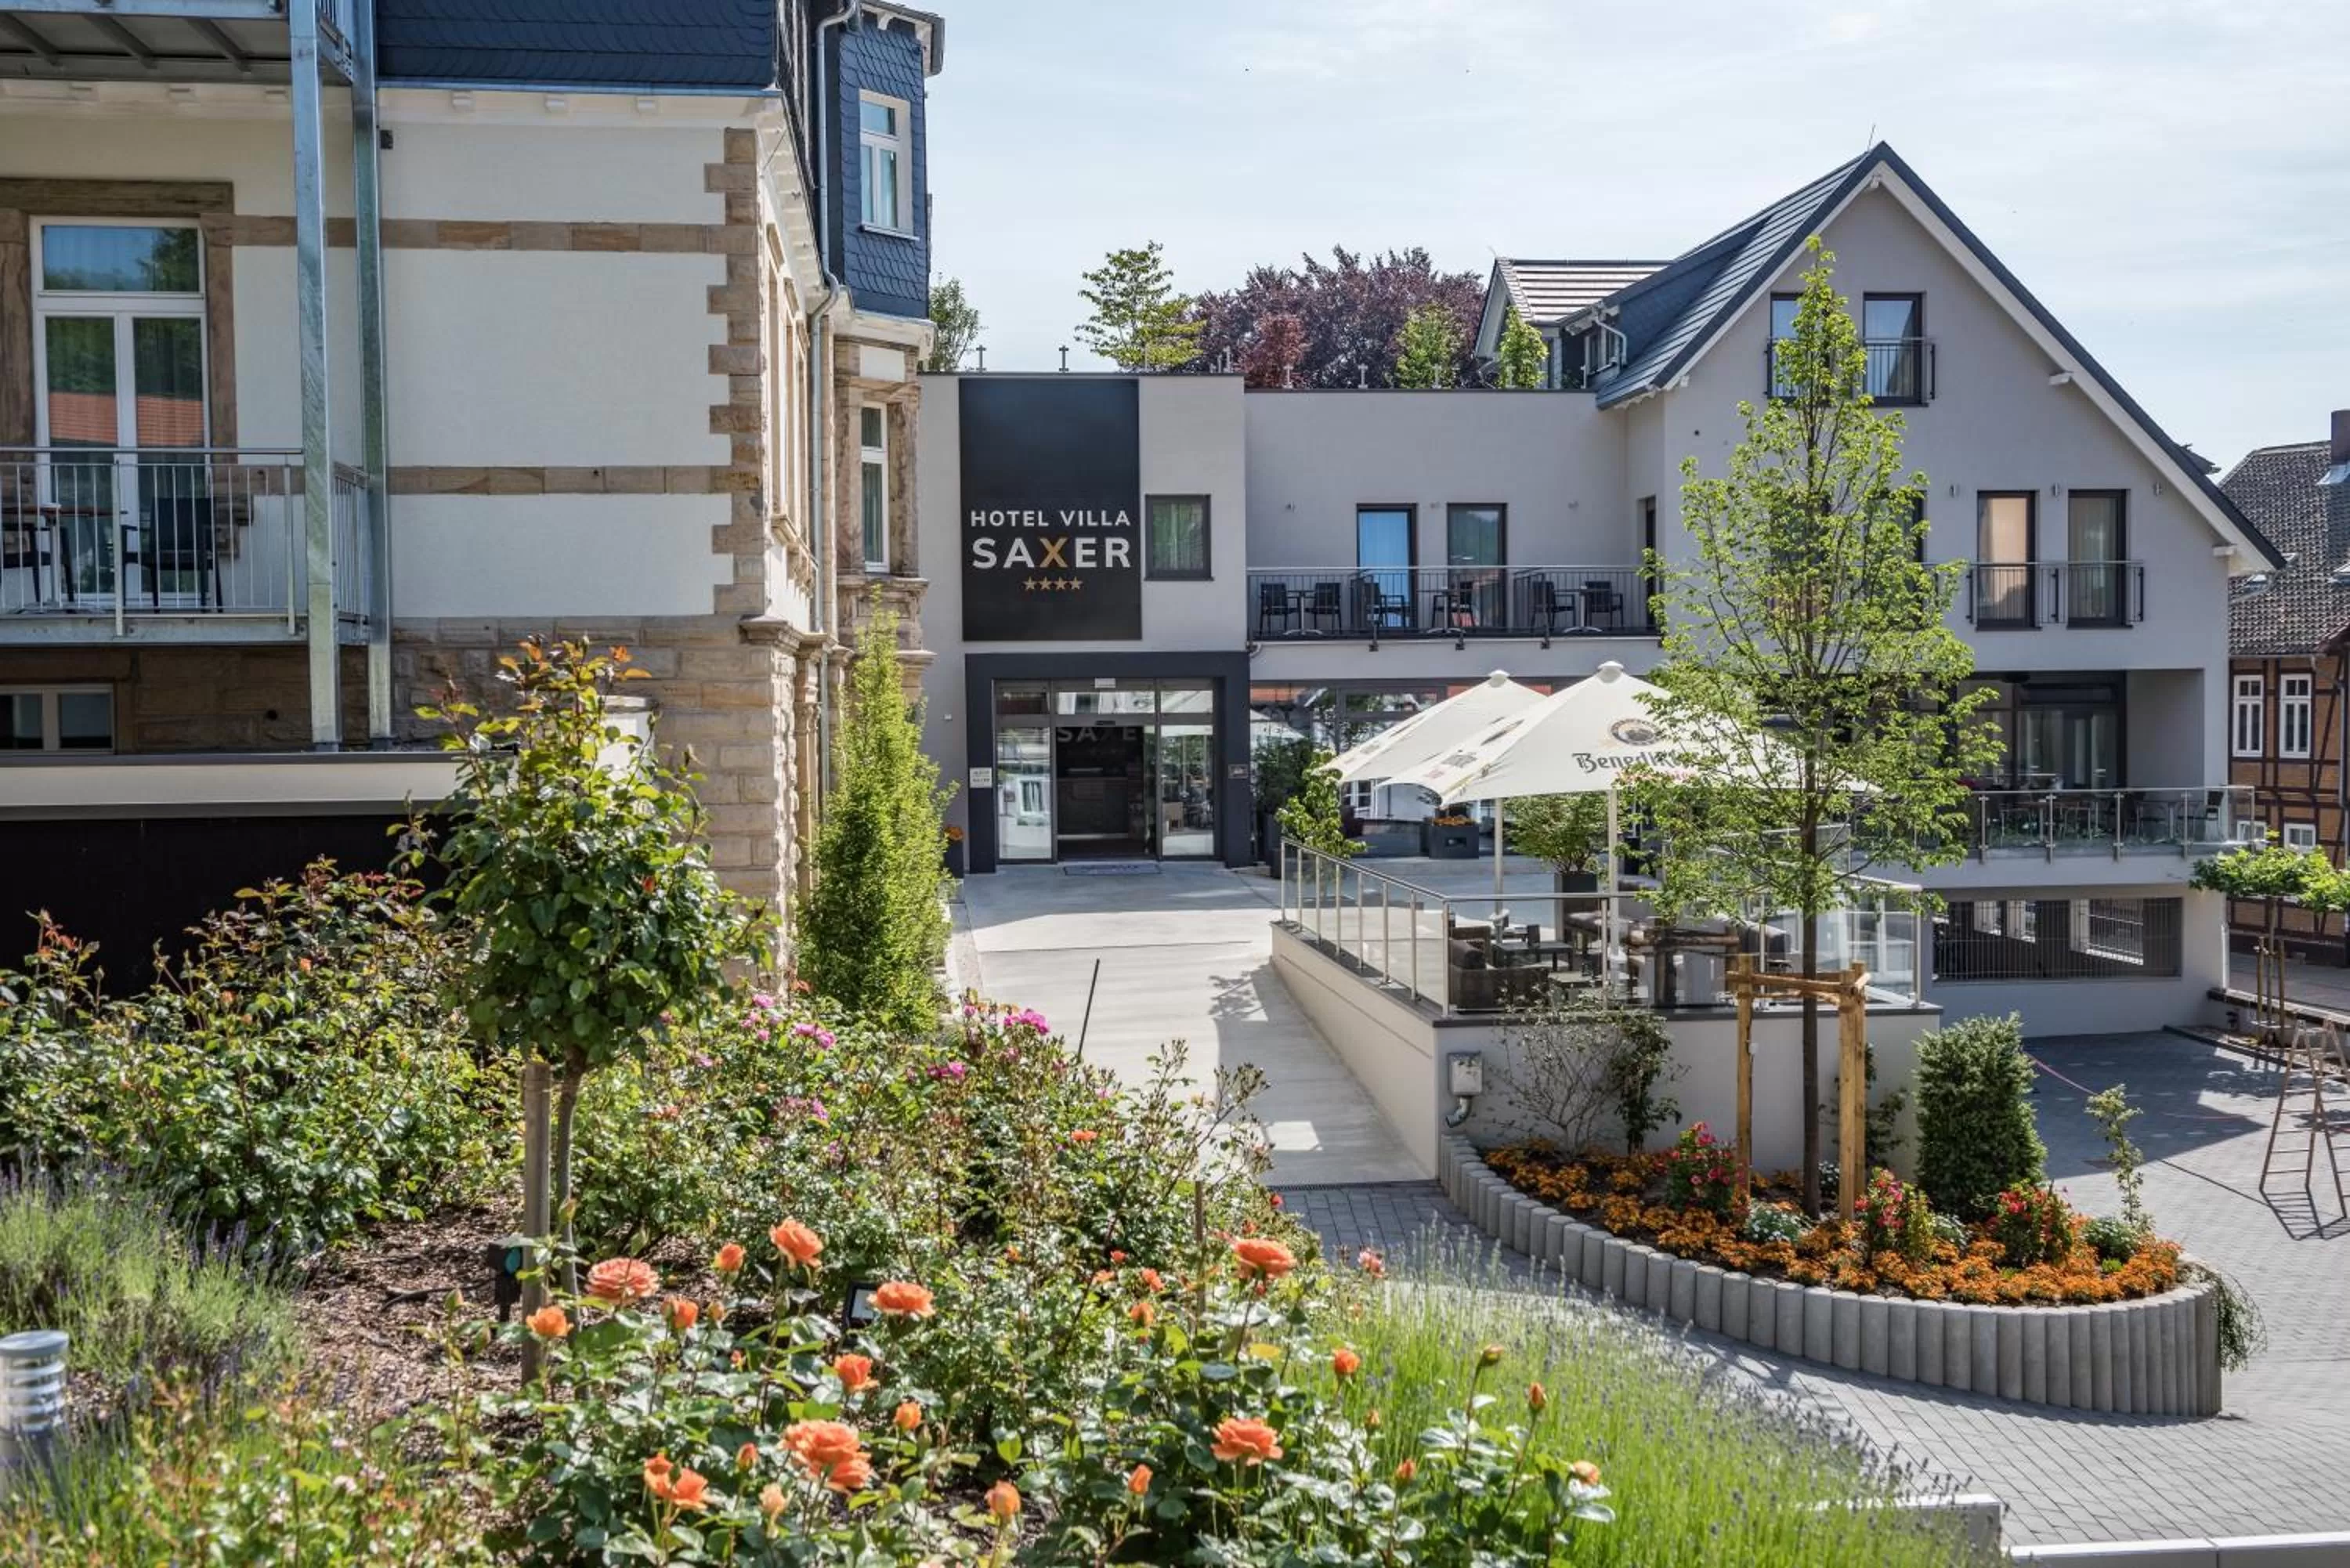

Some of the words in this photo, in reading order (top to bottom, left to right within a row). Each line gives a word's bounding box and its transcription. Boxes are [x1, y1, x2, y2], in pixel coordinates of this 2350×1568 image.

[971, 510, 1050, 527] HOTEL
[1059, 510, 1131, 526] VILLA
[971, 537, 1131, 569] SAXER
